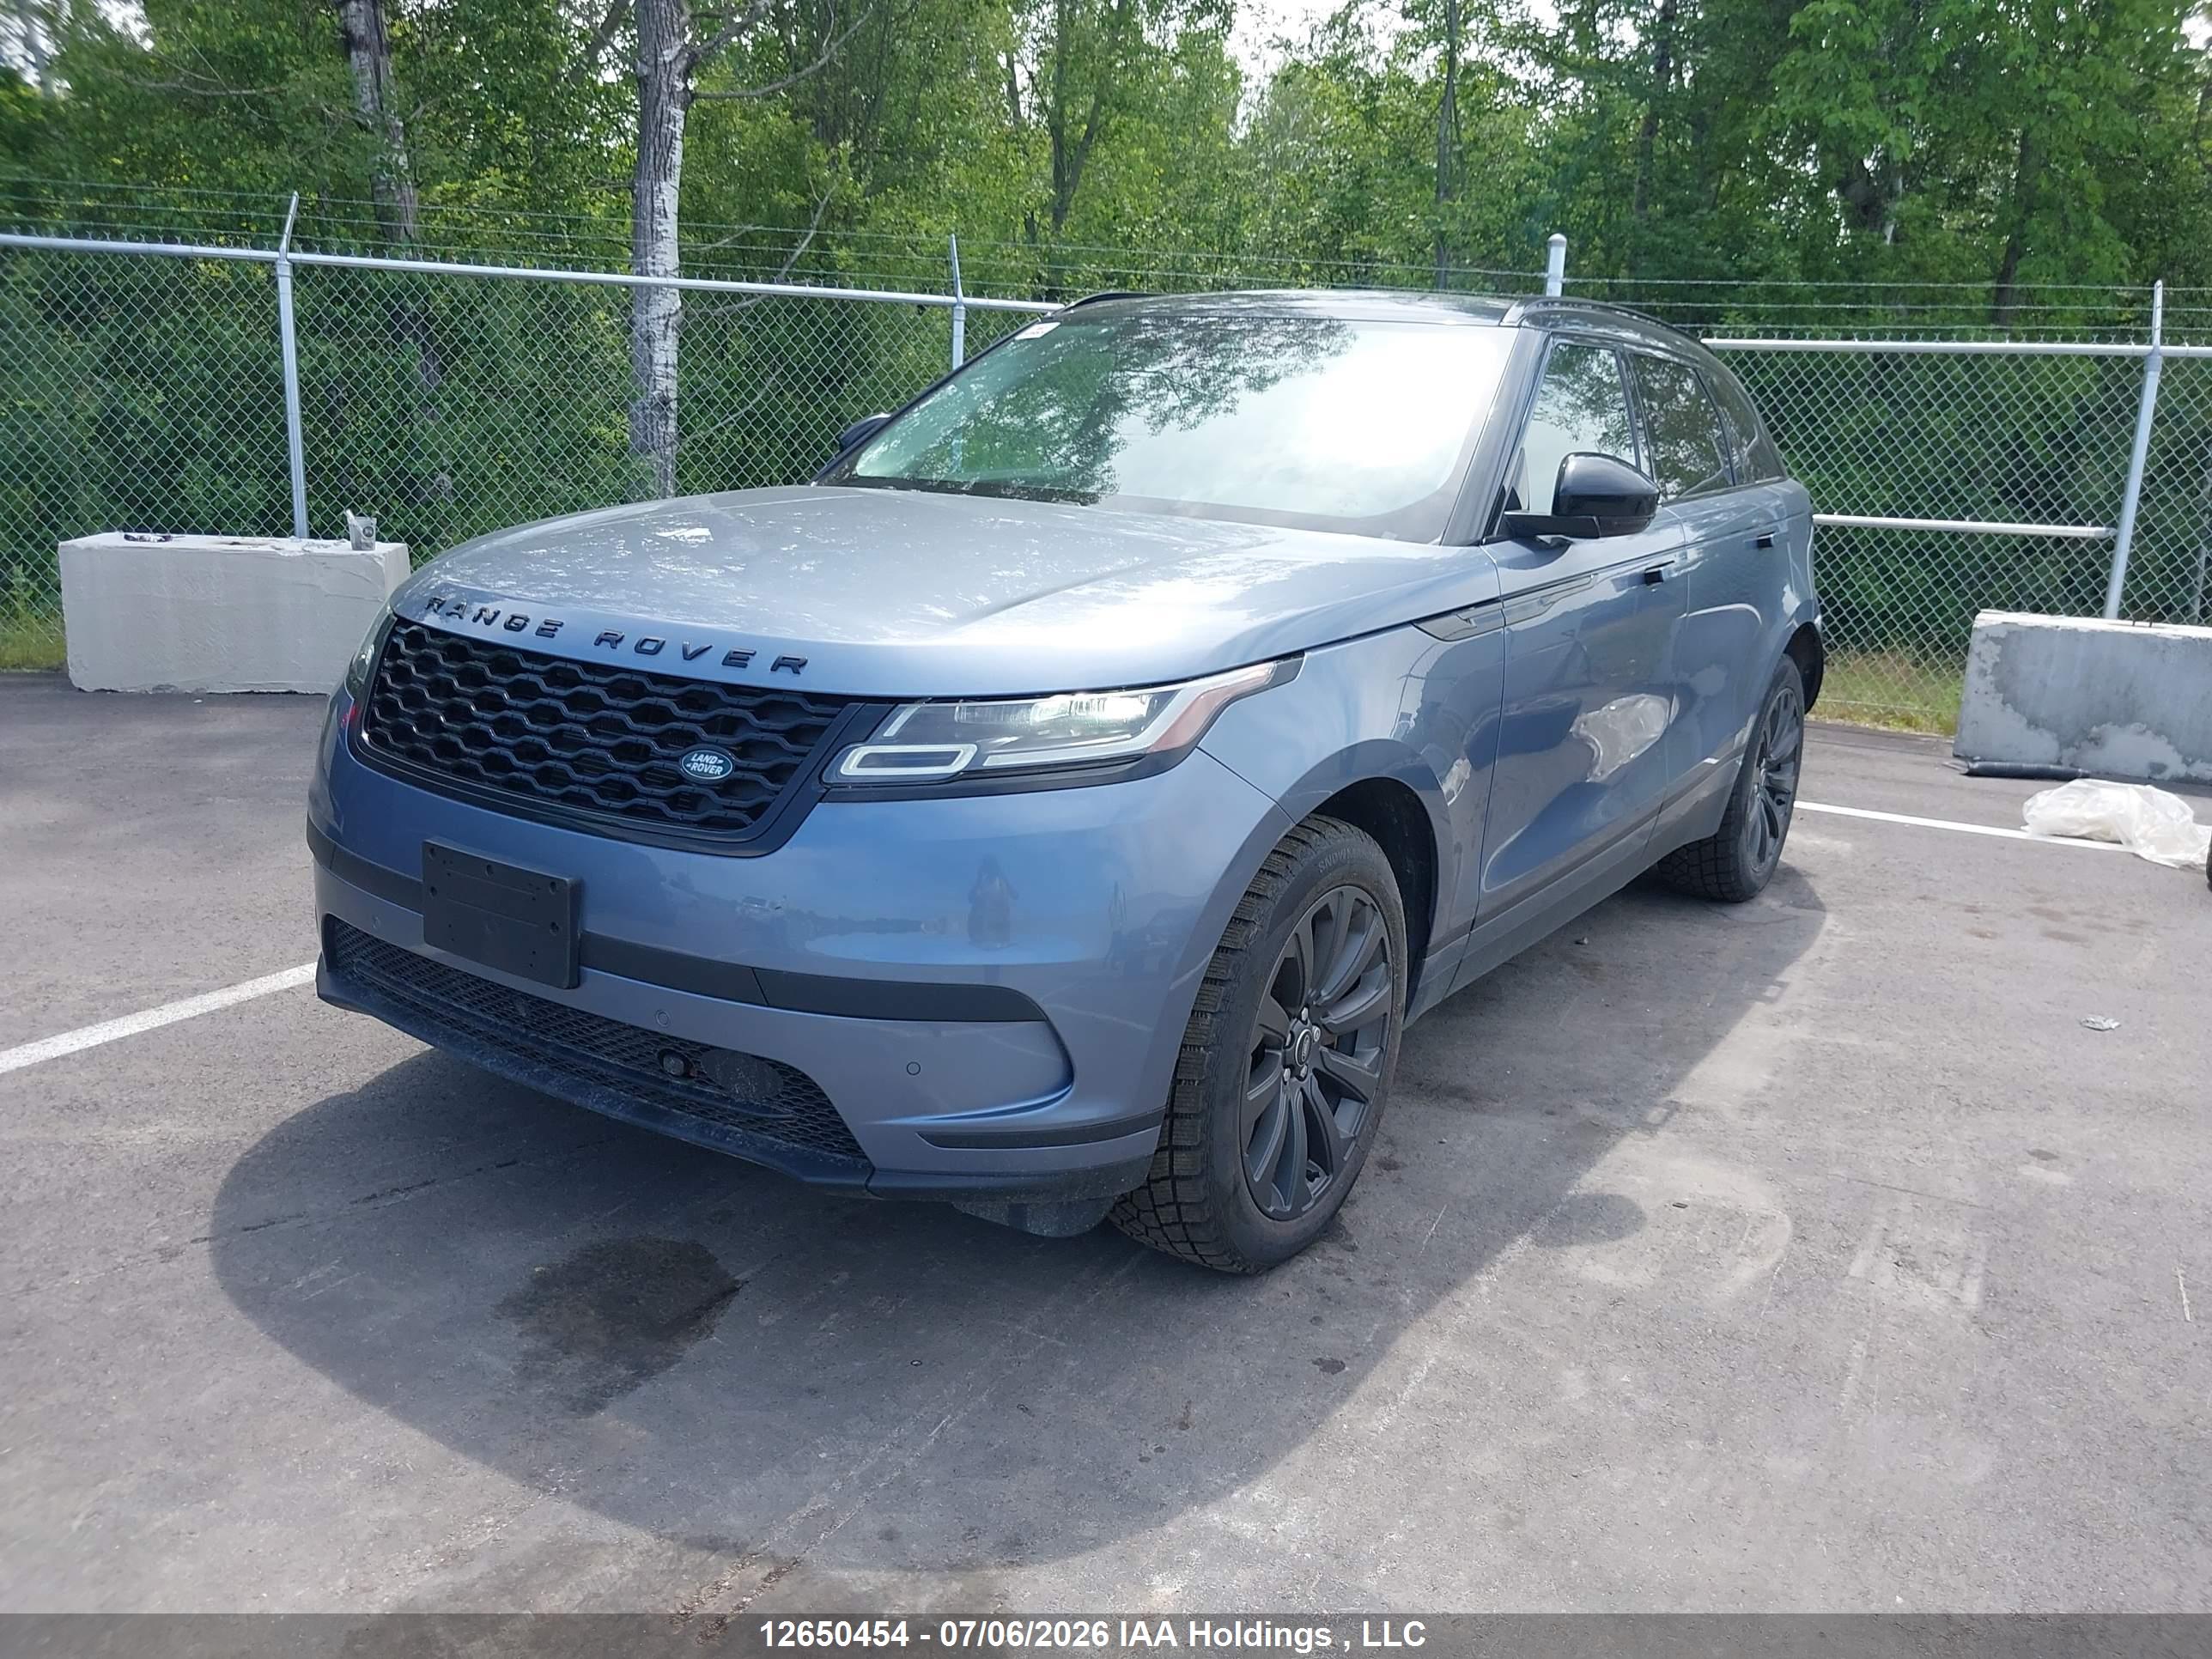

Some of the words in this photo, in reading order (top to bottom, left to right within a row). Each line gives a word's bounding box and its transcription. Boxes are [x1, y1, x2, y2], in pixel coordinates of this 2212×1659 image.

[425, 597, 564, 638] RANGE
[593, 628, 809, 675] ROVER
[690, 763, 724, 775] ROVER
